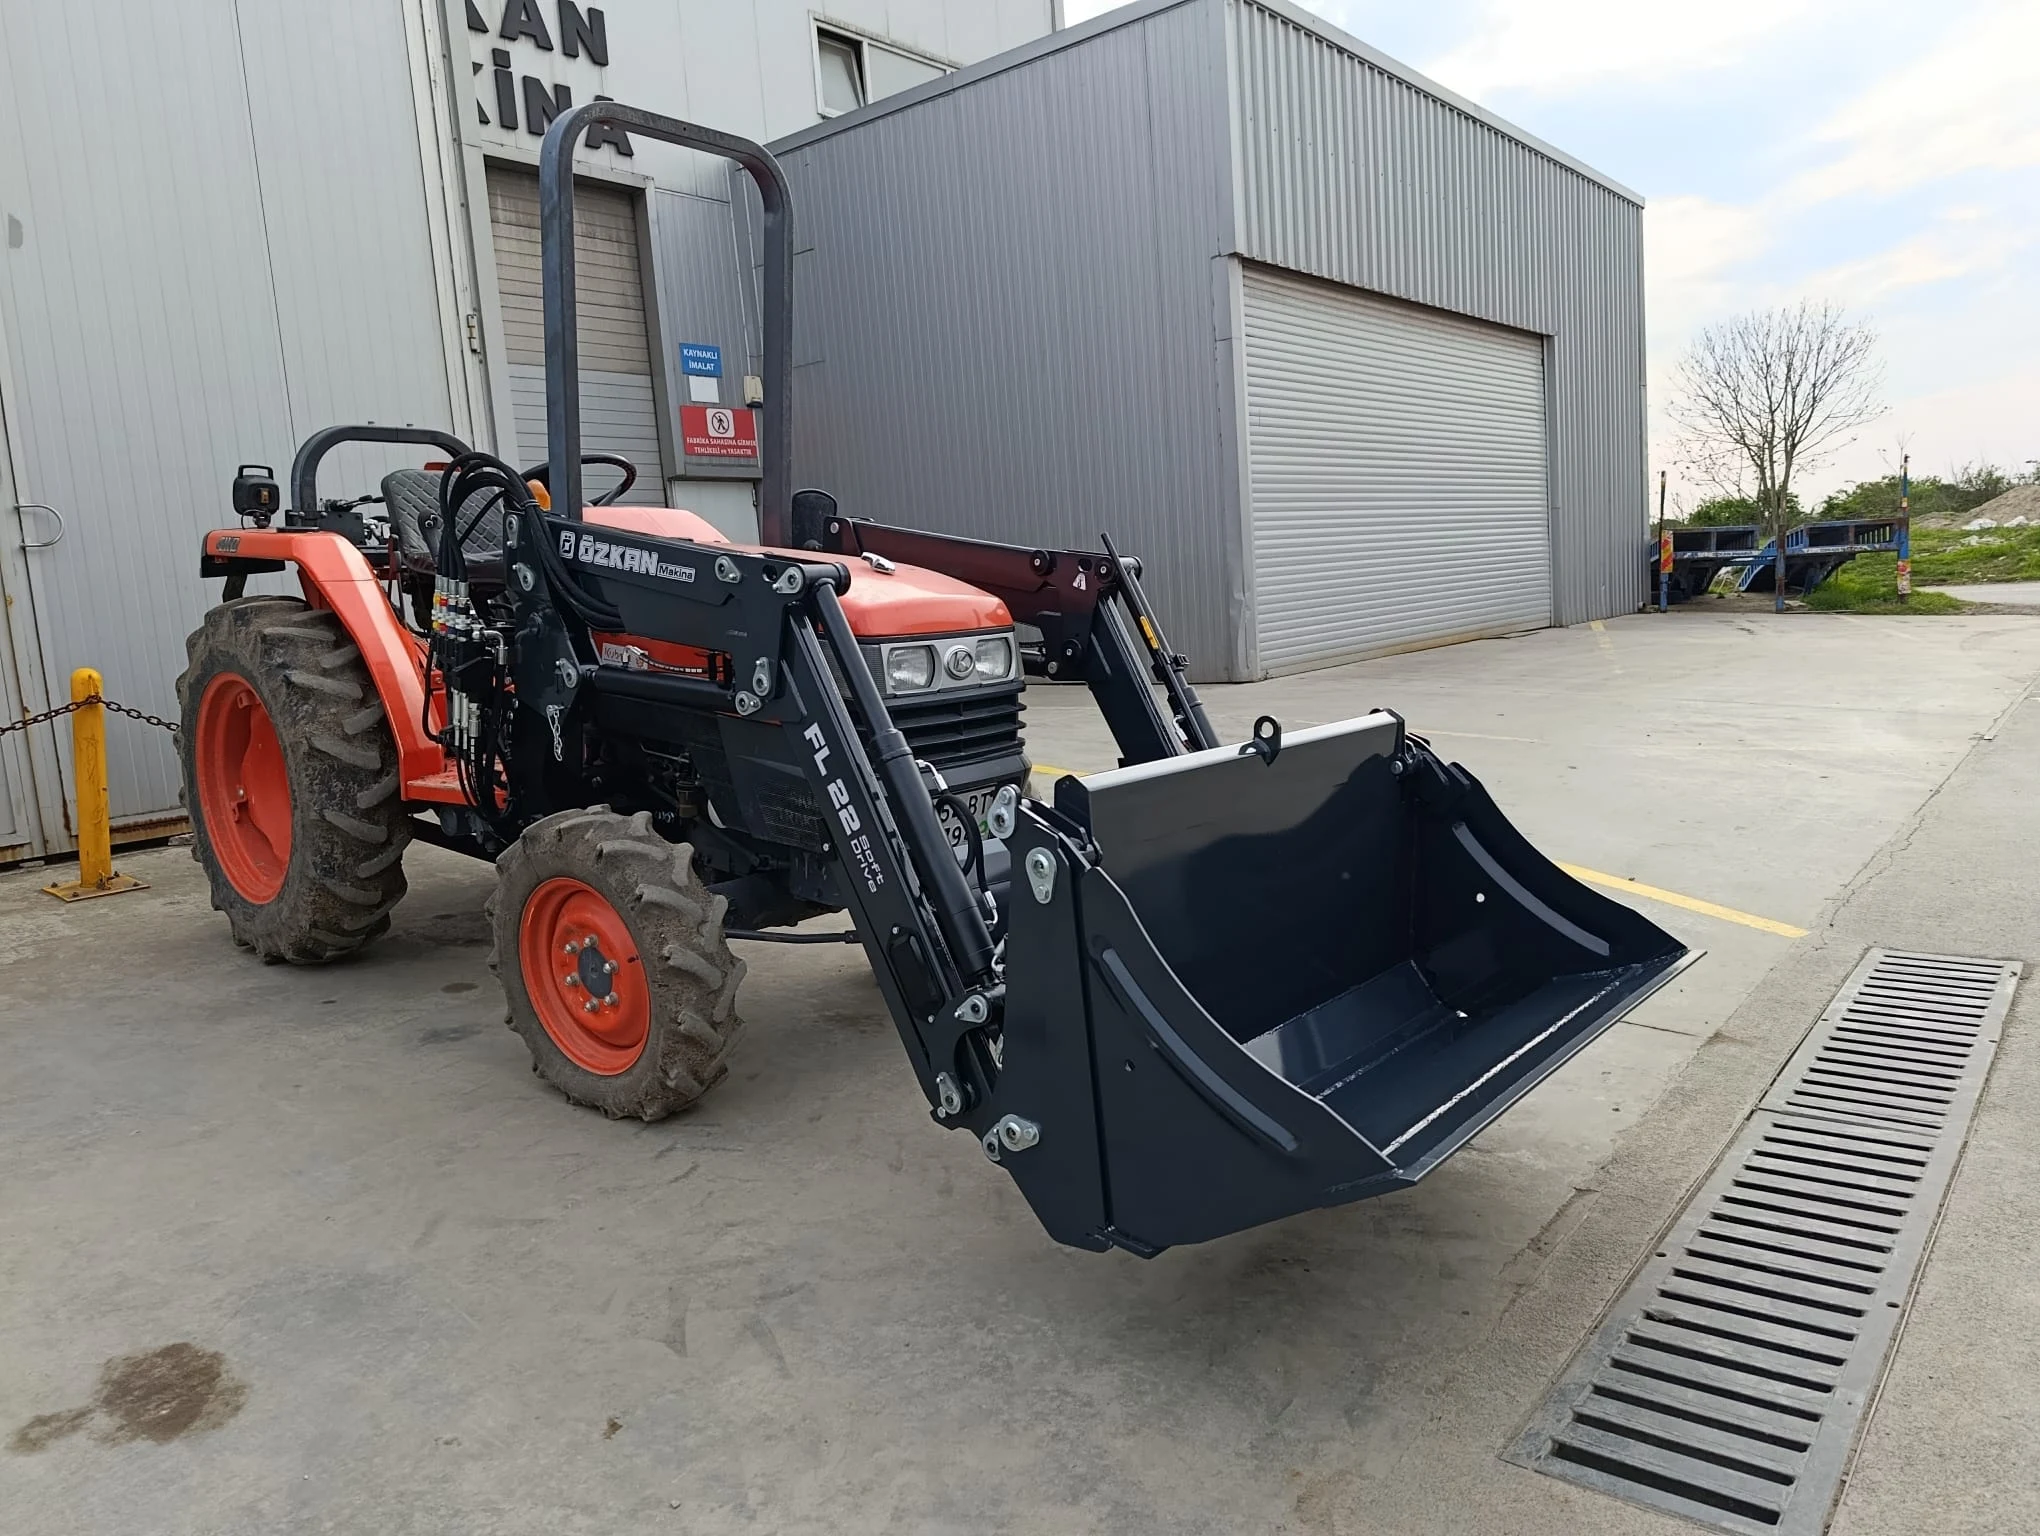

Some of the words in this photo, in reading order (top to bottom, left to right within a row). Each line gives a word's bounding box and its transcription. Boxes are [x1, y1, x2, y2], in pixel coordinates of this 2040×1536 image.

[683, 348, 718, 360] KAYNAKLI
[688, 359, 715, 371] İMALAT
[578, 534, 659, 577] ÖZKAN
[658, 564, 694, 581] Makina
[803, 722, 831, 777] FL
[827, 778, 861, 836] 22
[851, 839, 877, 893] Drive
[859, 834, 885, 885] Soft
